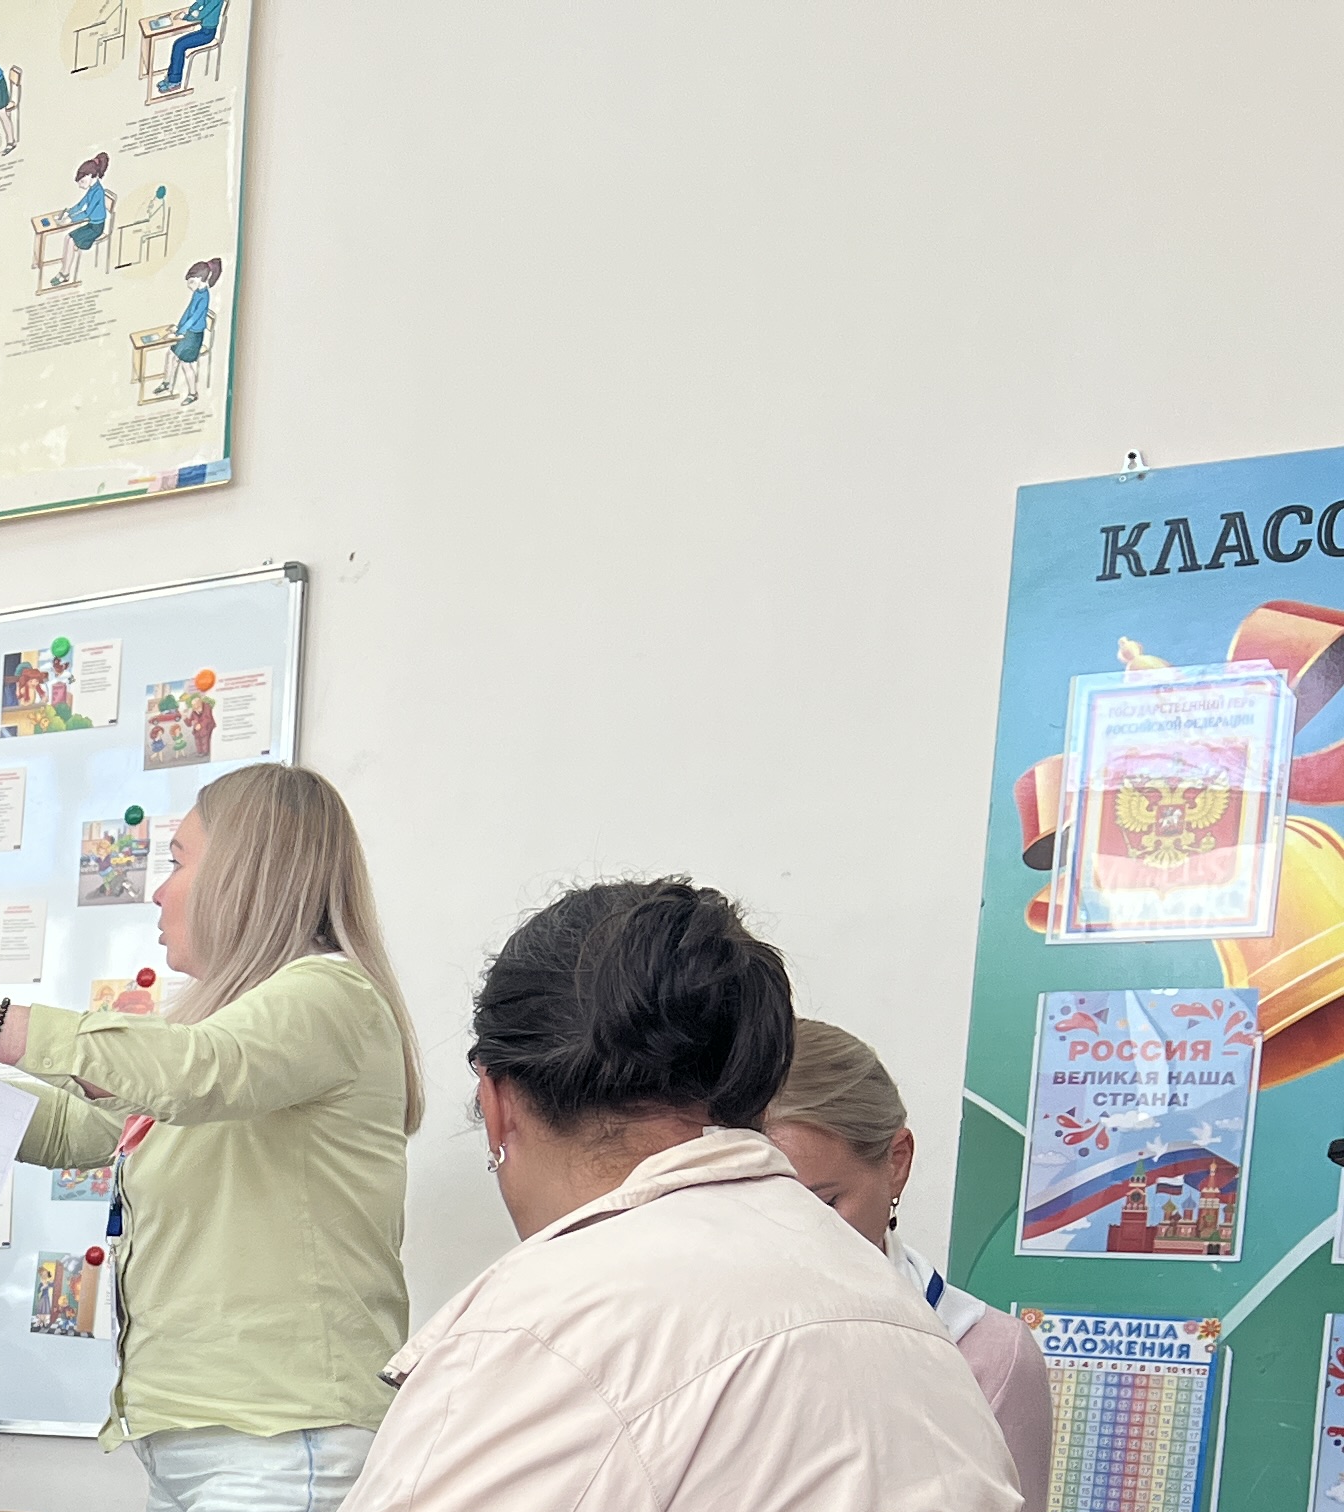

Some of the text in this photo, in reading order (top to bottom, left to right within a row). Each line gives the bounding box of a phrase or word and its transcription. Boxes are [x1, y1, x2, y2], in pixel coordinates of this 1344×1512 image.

[1068, 1039, 1212, 1062] РОССИЯ
[1053, 1071, 1236, 1086] ВЕЛИКАЯ НАША
[1092, 1092, 1189, 1107] СТРАНА!
[1058, 1318, 1179, 1340] ТАБЛИЦА
[1044, 1335, 1191, 1359] СЛОЖЕНИЯ
